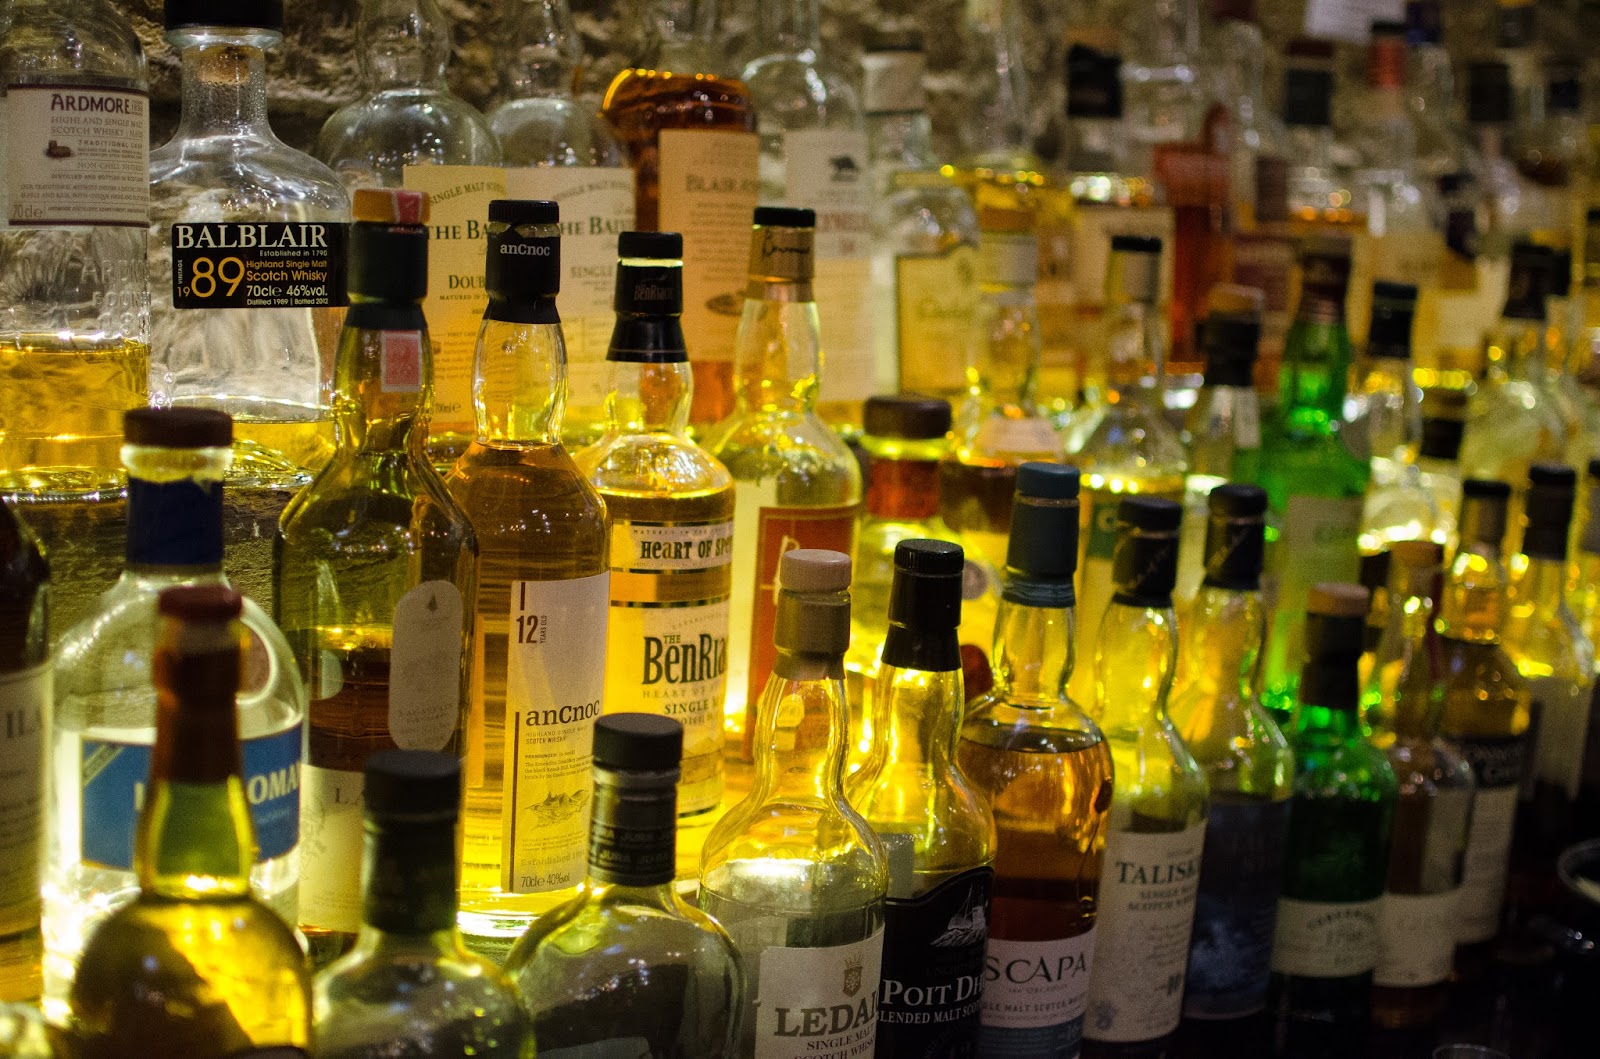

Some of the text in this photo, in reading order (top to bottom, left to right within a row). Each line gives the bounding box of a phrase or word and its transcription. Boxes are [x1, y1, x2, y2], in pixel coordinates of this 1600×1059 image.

[50, 94, 130, 115] ARDMORE
[51, 126, 90, 135] SCOTCH
[175, 225, 328, 249] BALBLAIR
[246, 260, 328, 270] Highland Single Malt
[246, 270, 328, 283] Scotch Whisky
[286, 285, 328, 297] 46%vol.
[247, 298, 272, 306] Distilled
[273, 298, 289, 306] 1989
[294, 298, 315, 306] Bottled
[697, 540, 713, 559] OF
[516, 615, 539, 644] 12
[663, 635, 681, 644] THE
[665, 700, 709, 714] SINGLE
[525, 730, 556, 738] HIGHLAND
[526, 736, 566, 745] SCOTCH WHISKY
[520, 853, 570, 867] Established
[985, 951, 1087, 984] SCAPA
[1005, 1004, 1030, 1012] MALT
[933, 1008, 962, 1023] MALT
[806, 1034, 853, 1051] SINGLE
